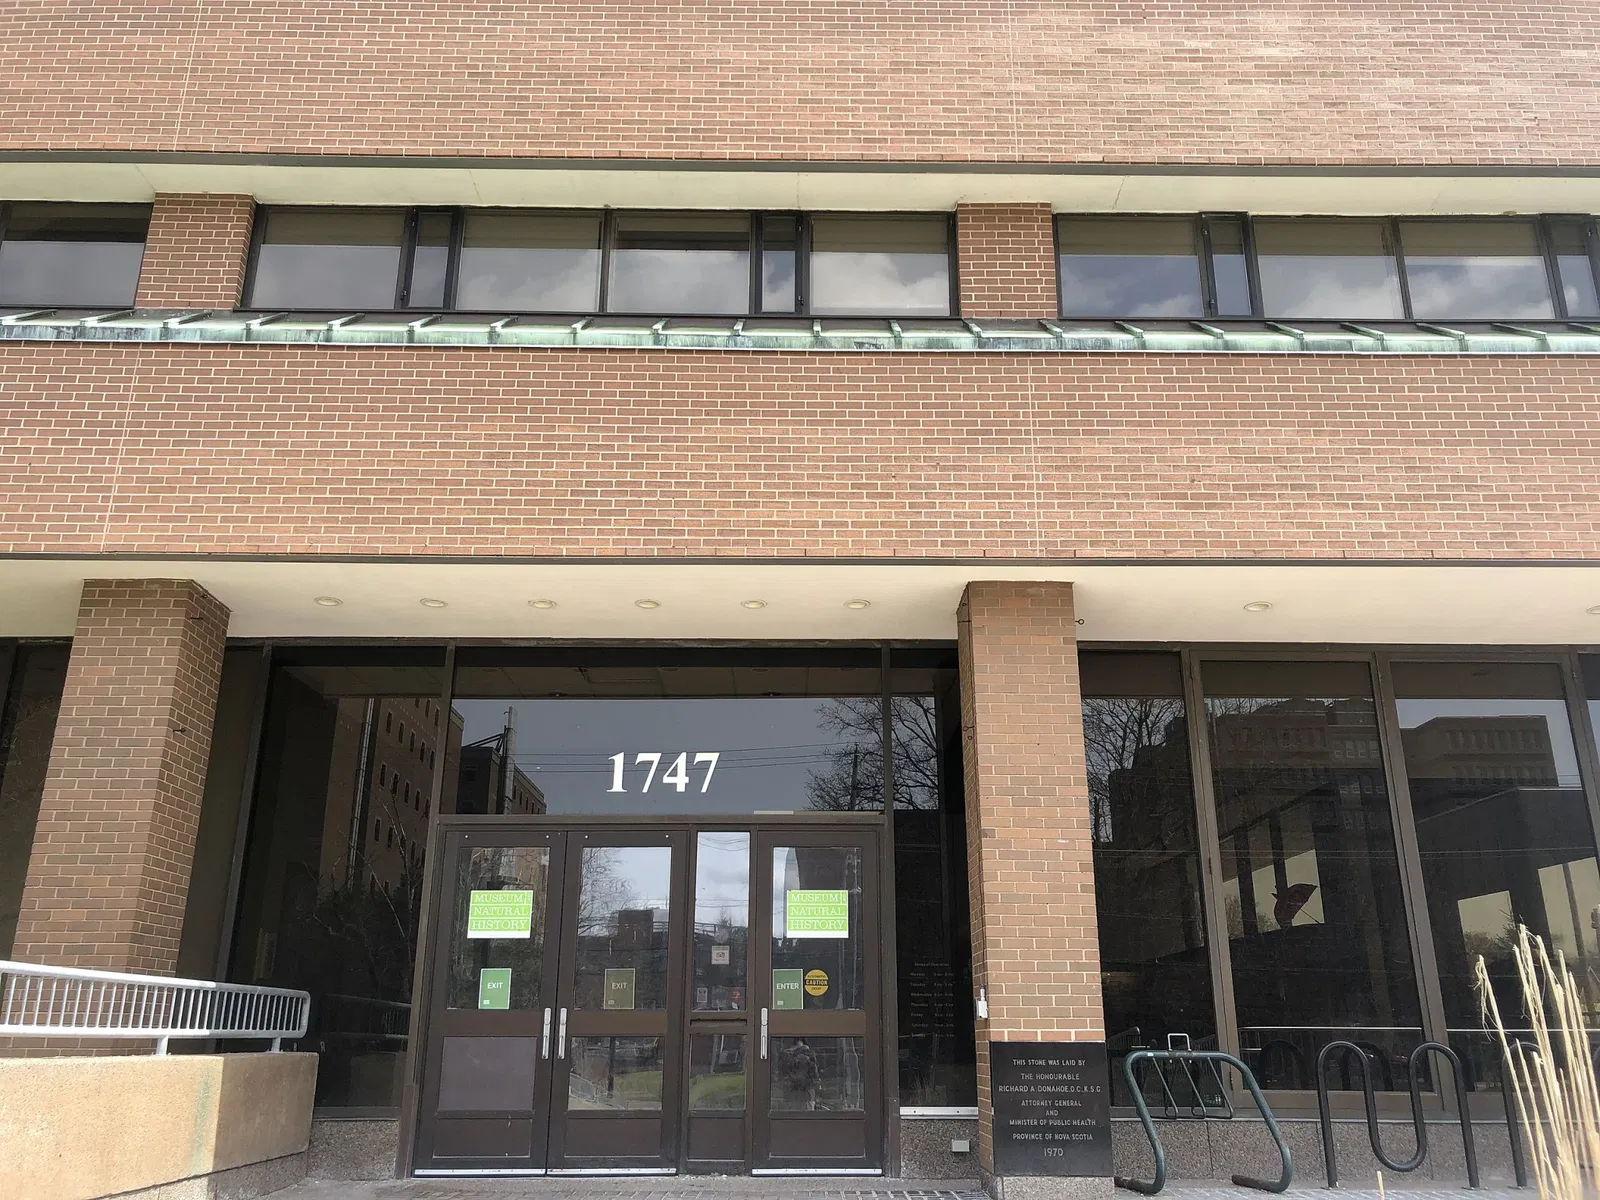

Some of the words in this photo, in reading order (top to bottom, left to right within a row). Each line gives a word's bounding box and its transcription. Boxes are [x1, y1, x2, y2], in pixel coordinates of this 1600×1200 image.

[606, 752, 720, 793] 1747
[474, 893, 523, 903] MUSEUM
[791, 893, 839, 902] MUSEUM
[473, 906, 528, 916] NATURAL
[791, 906, 845, 916] NATURAL
[472, 919, 528, 930] HISTORY
[790, 919, 845, 930] HISTORY
[776, 982, 800, 990] ENTER
[998, 1085, 1029, 1093] RICHARD
[1021, 1099, 1053, 1107] ATTORNEY
[1055, 1099, 1082, 1107] GENERAL
[1072, 1118, 1096, 1126] HEALTH
[1043, 1147, 1064, 1157] 1970
